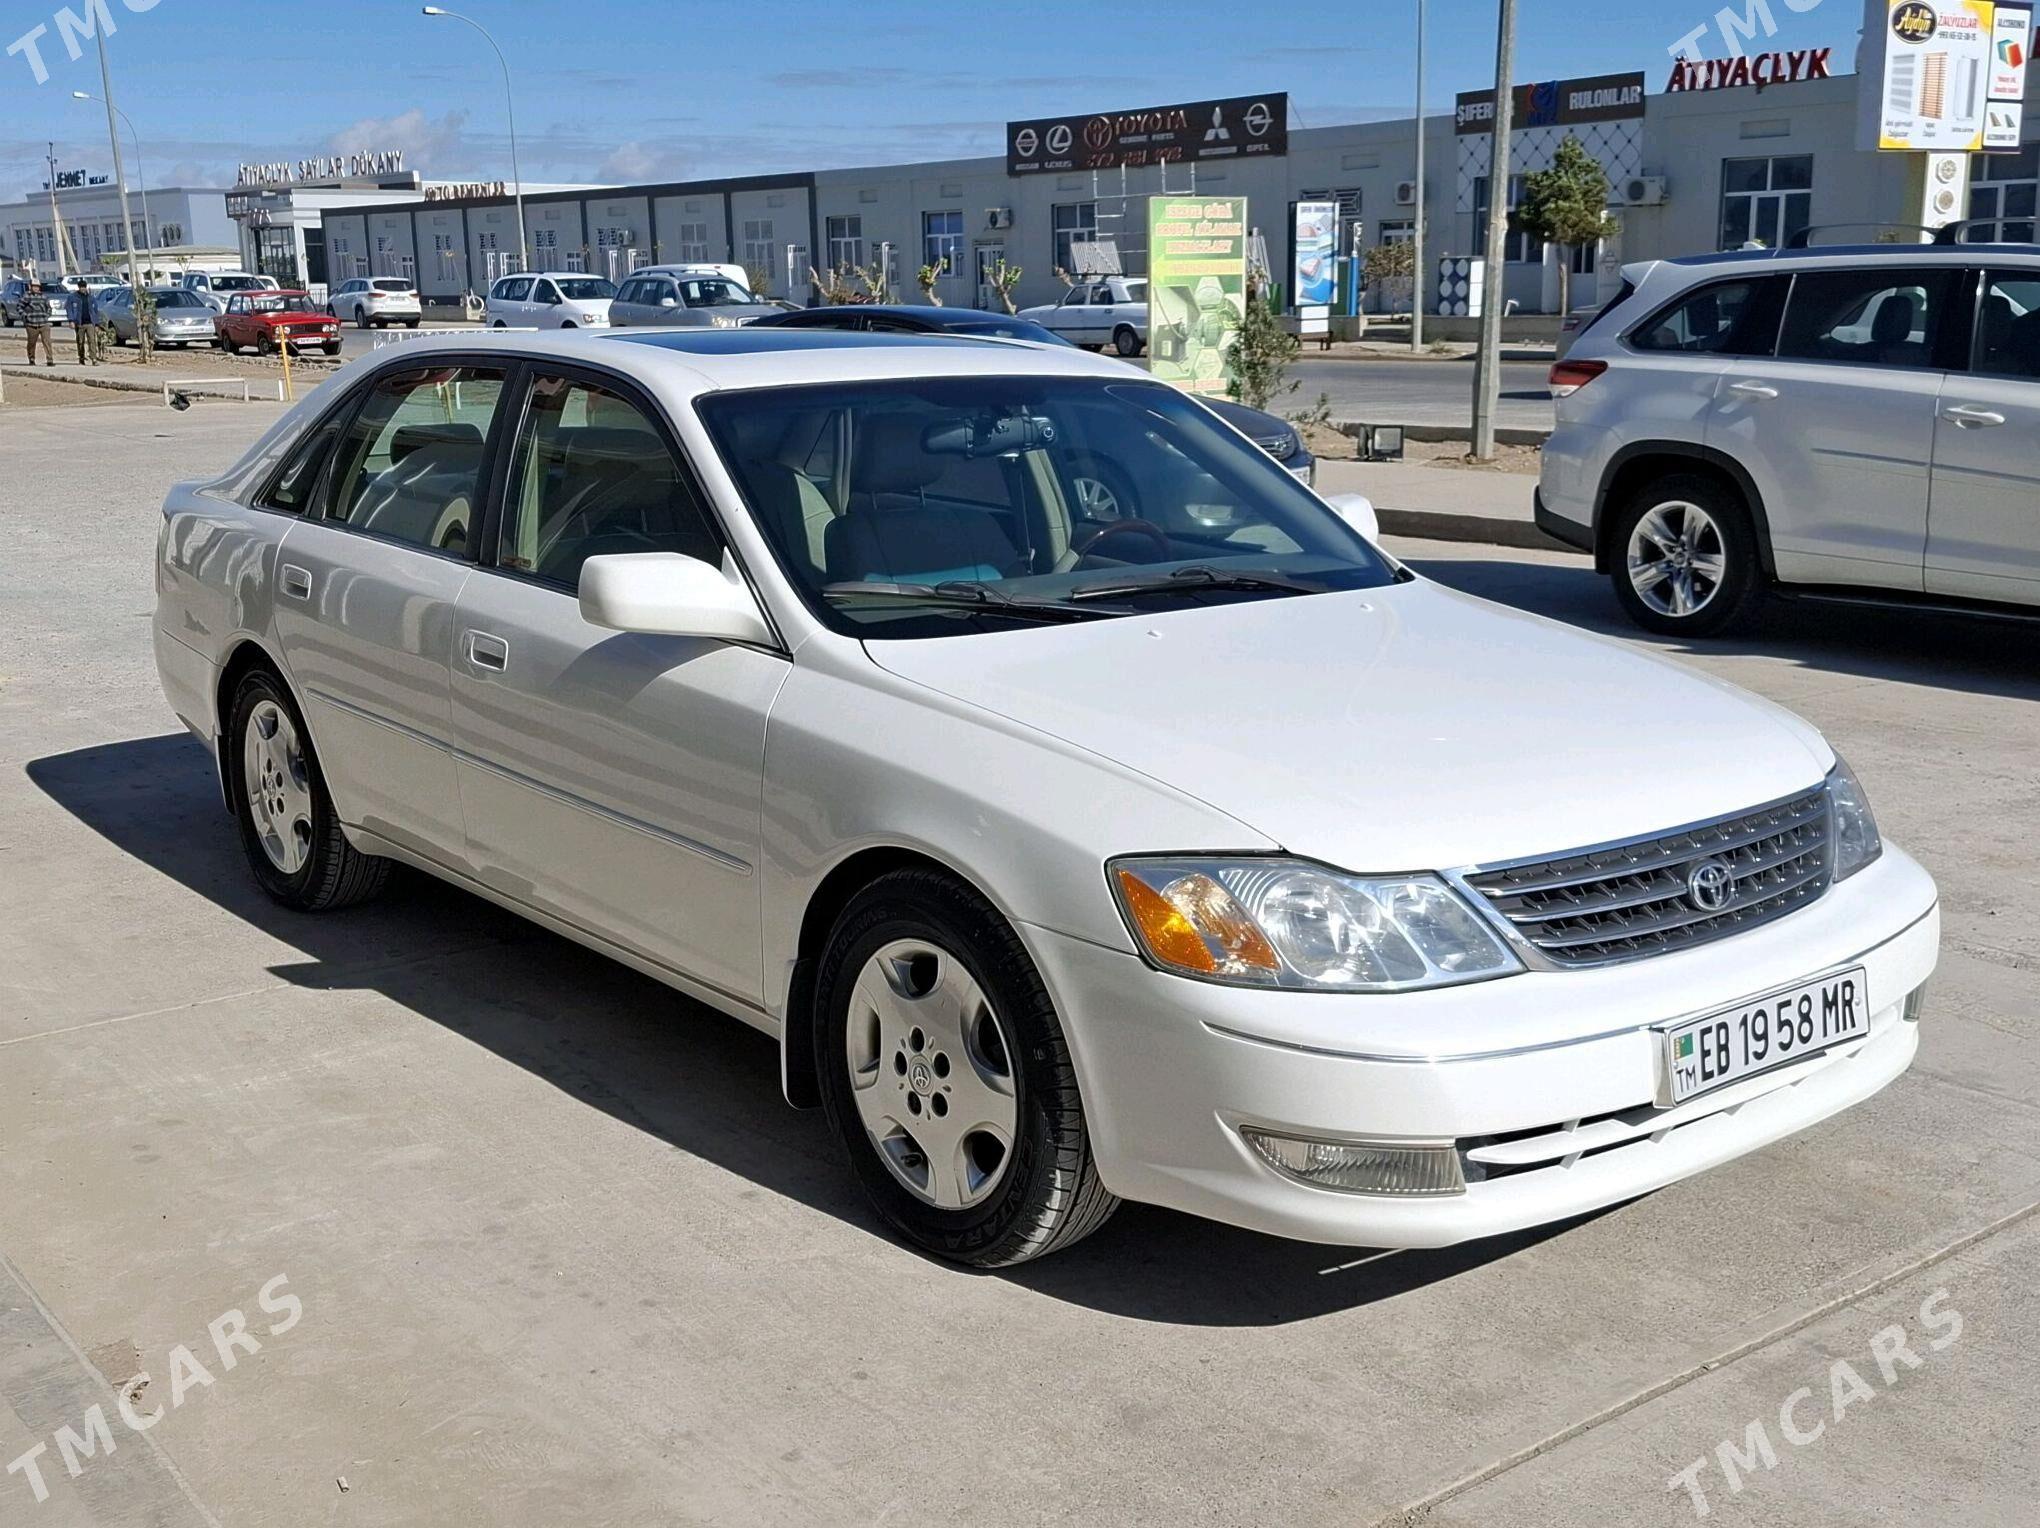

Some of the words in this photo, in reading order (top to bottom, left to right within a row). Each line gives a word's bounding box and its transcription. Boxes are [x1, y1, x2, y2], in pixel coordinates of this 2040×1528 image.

[1569, 85, 1642, 110] RULONLAR
[1114, 109, 1188, 136] TOYOTA
[1700, 1021, 1731, 1082] EB
[1822, 979, 1857, 1038] MR
[1676, 1064, 1697, 1093] TM
